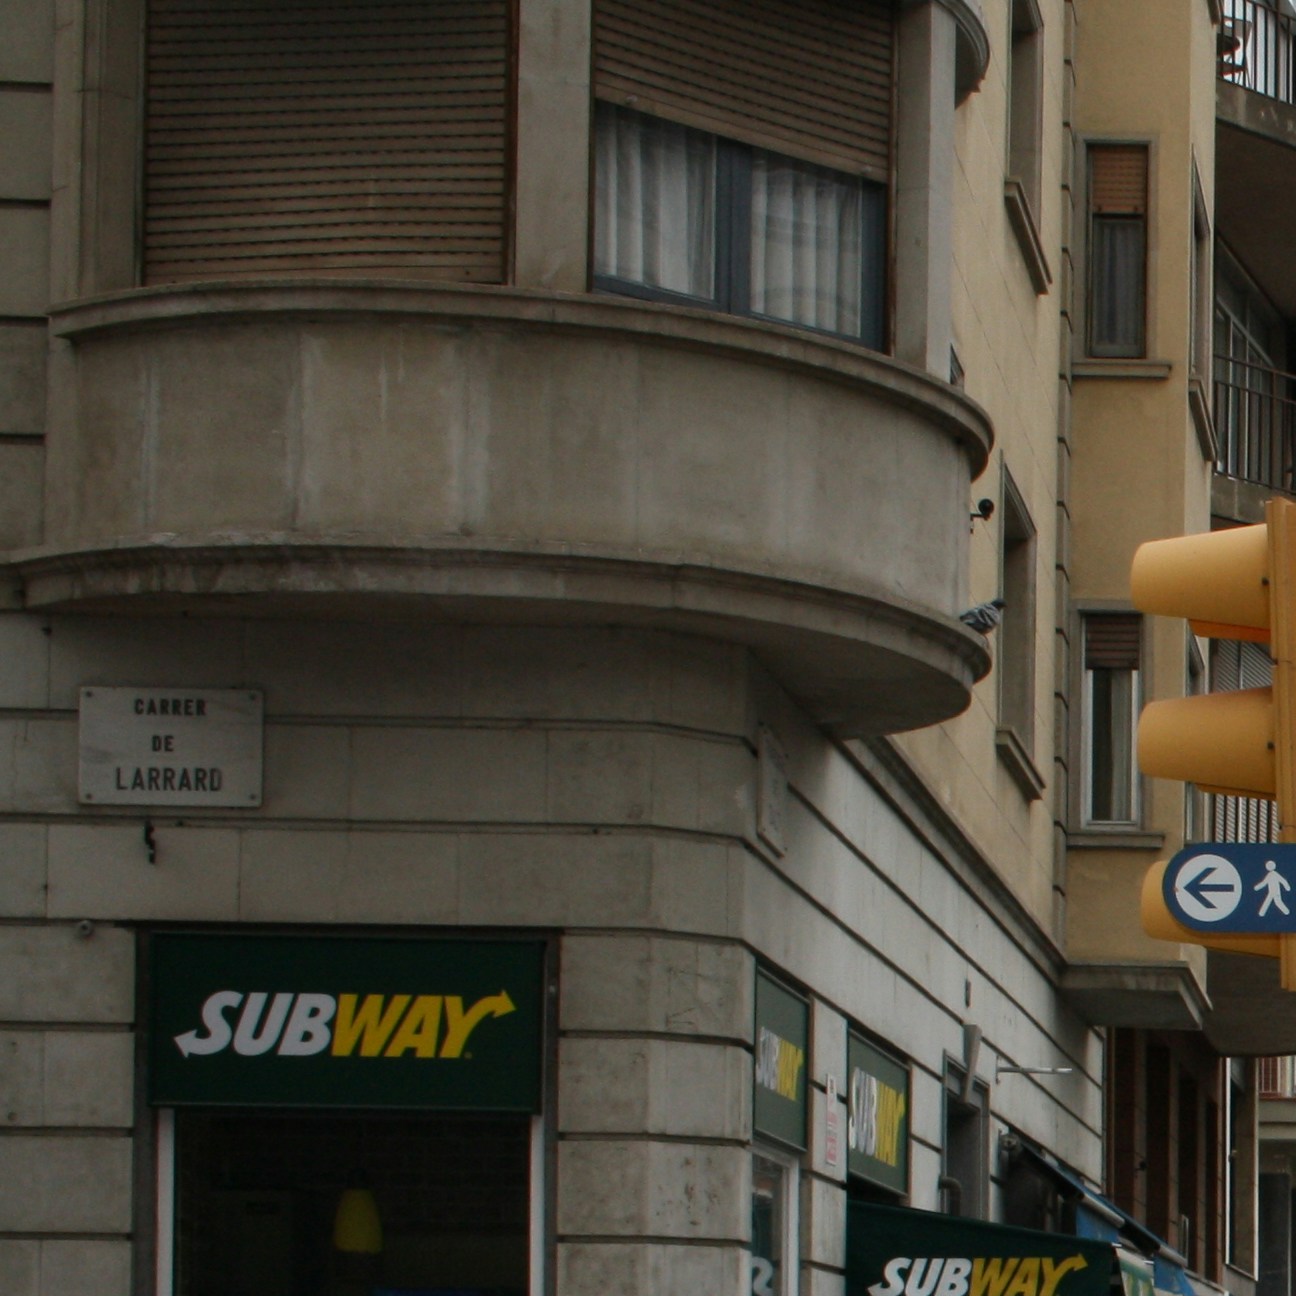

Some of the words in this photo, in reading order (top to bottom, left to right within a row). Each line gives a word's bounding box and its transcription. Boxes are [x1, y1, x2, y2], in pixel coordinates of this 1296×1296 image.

[134, 698, 207, 716] CARRER
[152, 735, 174, 751] DE
[115, 767, 222, 791] LARRARD
[174, 990, 516, 1058] SUBWAY
[756, 1026, 804, 1101] SUBWAY
[849, 1066, 906, 1168] SUBWAY
